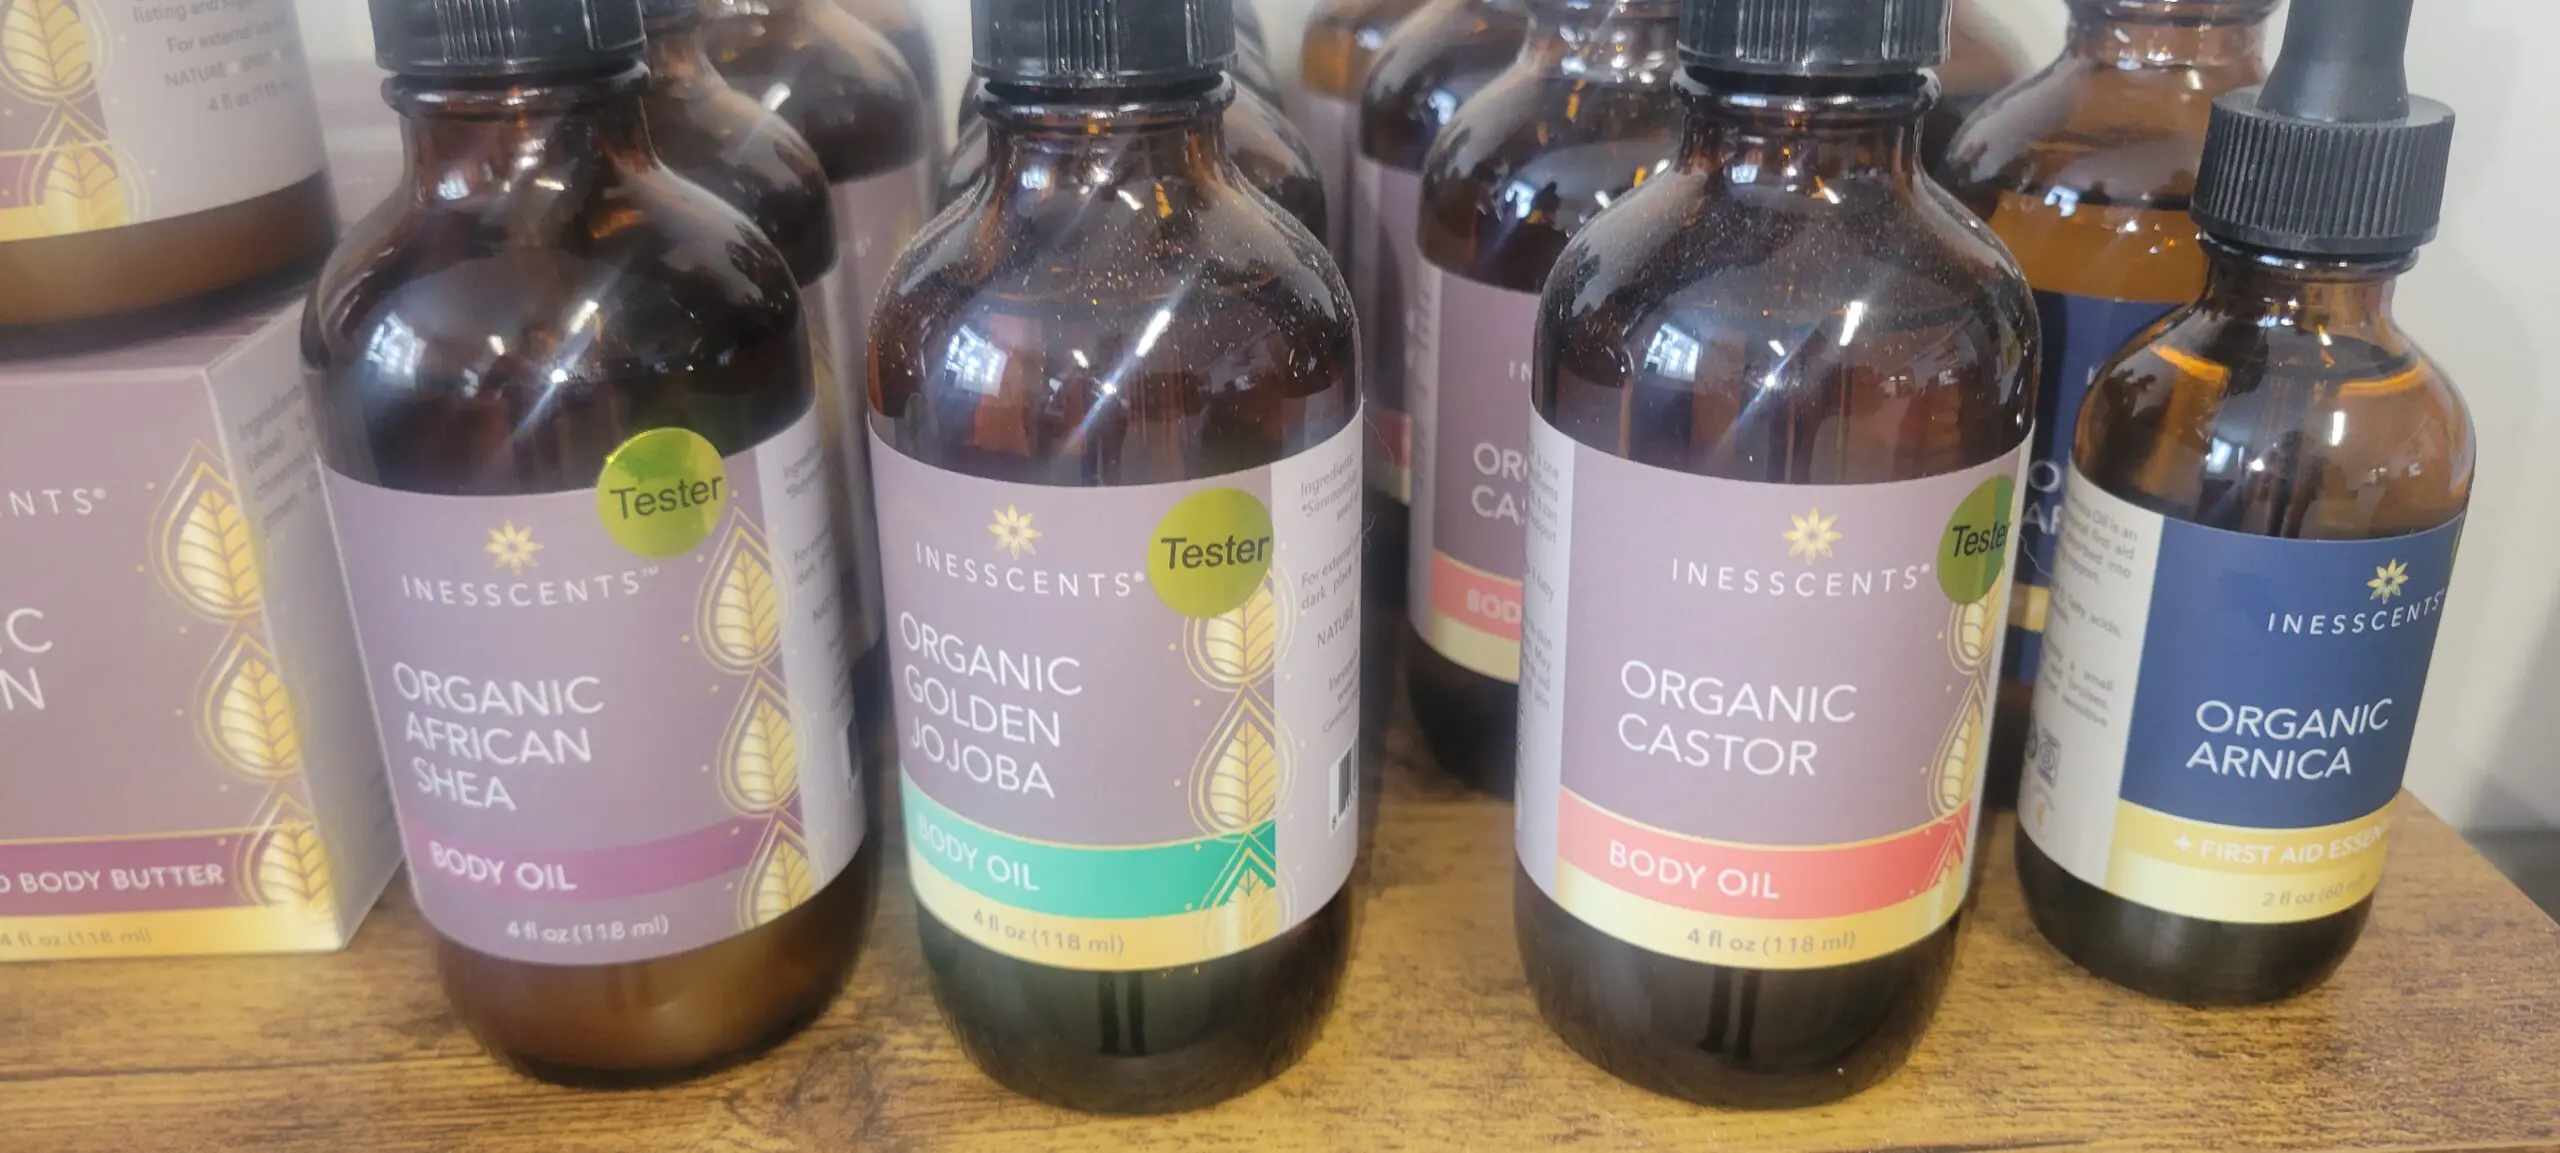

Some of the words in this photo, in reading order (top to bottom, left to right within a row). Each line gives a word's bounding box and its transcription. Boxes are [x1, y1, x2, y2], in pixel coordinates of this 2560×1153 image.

[1473, 442, 1529, 483] OR
[0, 488, 94, 516] NTS
[610, 474, 724, 520] Tester
[1472, 485, 1527, 526] CA
[916, 541, 1131, 597] INESSCENTS
[1161, 534, 1270, 570] Tester
[1672, 558, 1919, 598] INESSCENTS
[1467, 587, 1522, 625] BOD
[2268, 596, 2442, 635] INESSCENTS
[0, 608, 54, 653] C
[900, 611, 1083, 696] ORGANIC
[392, 661, 604, 716] ORGANIC
[904, 664, 1061, 748] GOLDEN
[1620, 660, 1858, 726] ORGANIC
[405, 711, 593, 765] AFRICAN
[2196, 698, 2393, 741] ORGANIC
[909, 716, 1056, 799] JOJOBA
[1618, 714, 1818, 777] CASTOR
[2186, 741, 2353, 780] ARNICA
[412, 756, 517, 812] SHEA
[428, 841, 505, 887] BODY
[516, 861, 578, 892] OIL
[916, 812, 980, 871] BODY
[987, 853, 1041, 892] OIL
[1609, 840, 1706, 892] BODY
[1718, 868, 1781, 900] OIL
[2200, 838, 2275, 867] FIRST
[2278, 842, 2324, 865] AID
[19, 870, 101, 894] BODY
[110, 863, 226, 891] BUTTER
[2260, 891, 2275, 908] 2
[506, 920, 521, 939] 4
[542, 928, 569, 943] oz
[572, 920, 626, 944] (118
[632, 914, 669, 937] ml)
[973, 908, 984, 926] 4
[1004, 925, 1027, 942] oz
[1032, 927, 1081, 951] (118
[1088, 934, 1125, 956] ml)
[1687, 928, 1701, 945] 4
[1708, 929, 1722, 948] fl
[1729, 938, 1757, 952] oz
[1762, 935, 1815, 957] (118
[1821, 929, 1856, 951] ml)
